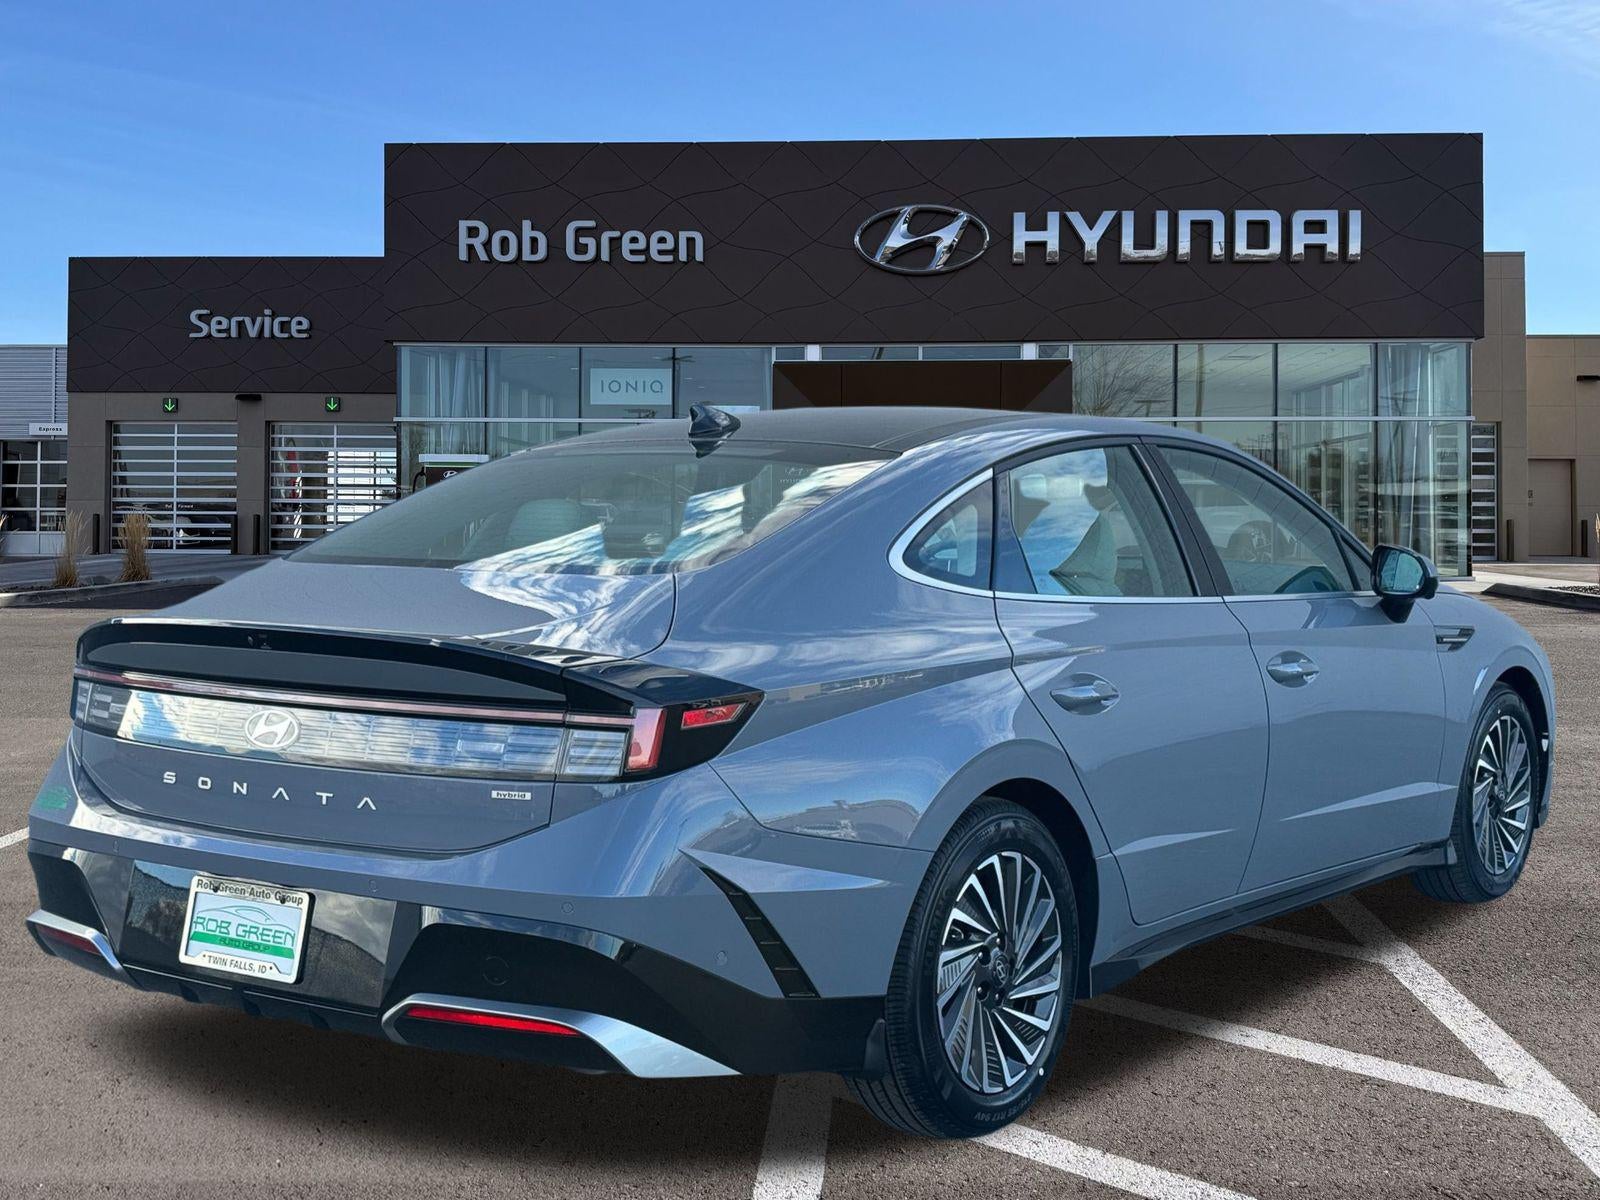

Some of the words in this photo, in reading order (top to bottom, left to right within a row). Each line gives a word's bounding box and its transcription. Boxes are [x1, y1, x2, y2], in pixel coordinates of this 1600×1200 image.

[458, 219, 549, 263] Rob
[565, 219, 705, 263] Green
[1011, 209, 1363, 264] HYUNDAI
[188, 308, 311, 338] Service
[600, 379, 664, 394] IONIQ
[162, 771, 377, 811] SONATA
[496, 791, 527, 799] hybrid
[196, 879, 217, 891] Rob
[218, 881, 246, 896] Green
[249, 887, 271, 900] Auto
[274, 891, 304, 906] Group
[193, 915, 232, 936] ROB
[235, 923, 296, 947] GREEN
[219, 937, 241, 948] AUTO
[242, 941, 271, 953] GROUP
[207, 954, 228, 967] TWIN
[229, 959, 256, 973] FALLS,
[258, 964, 267, 974] ID
